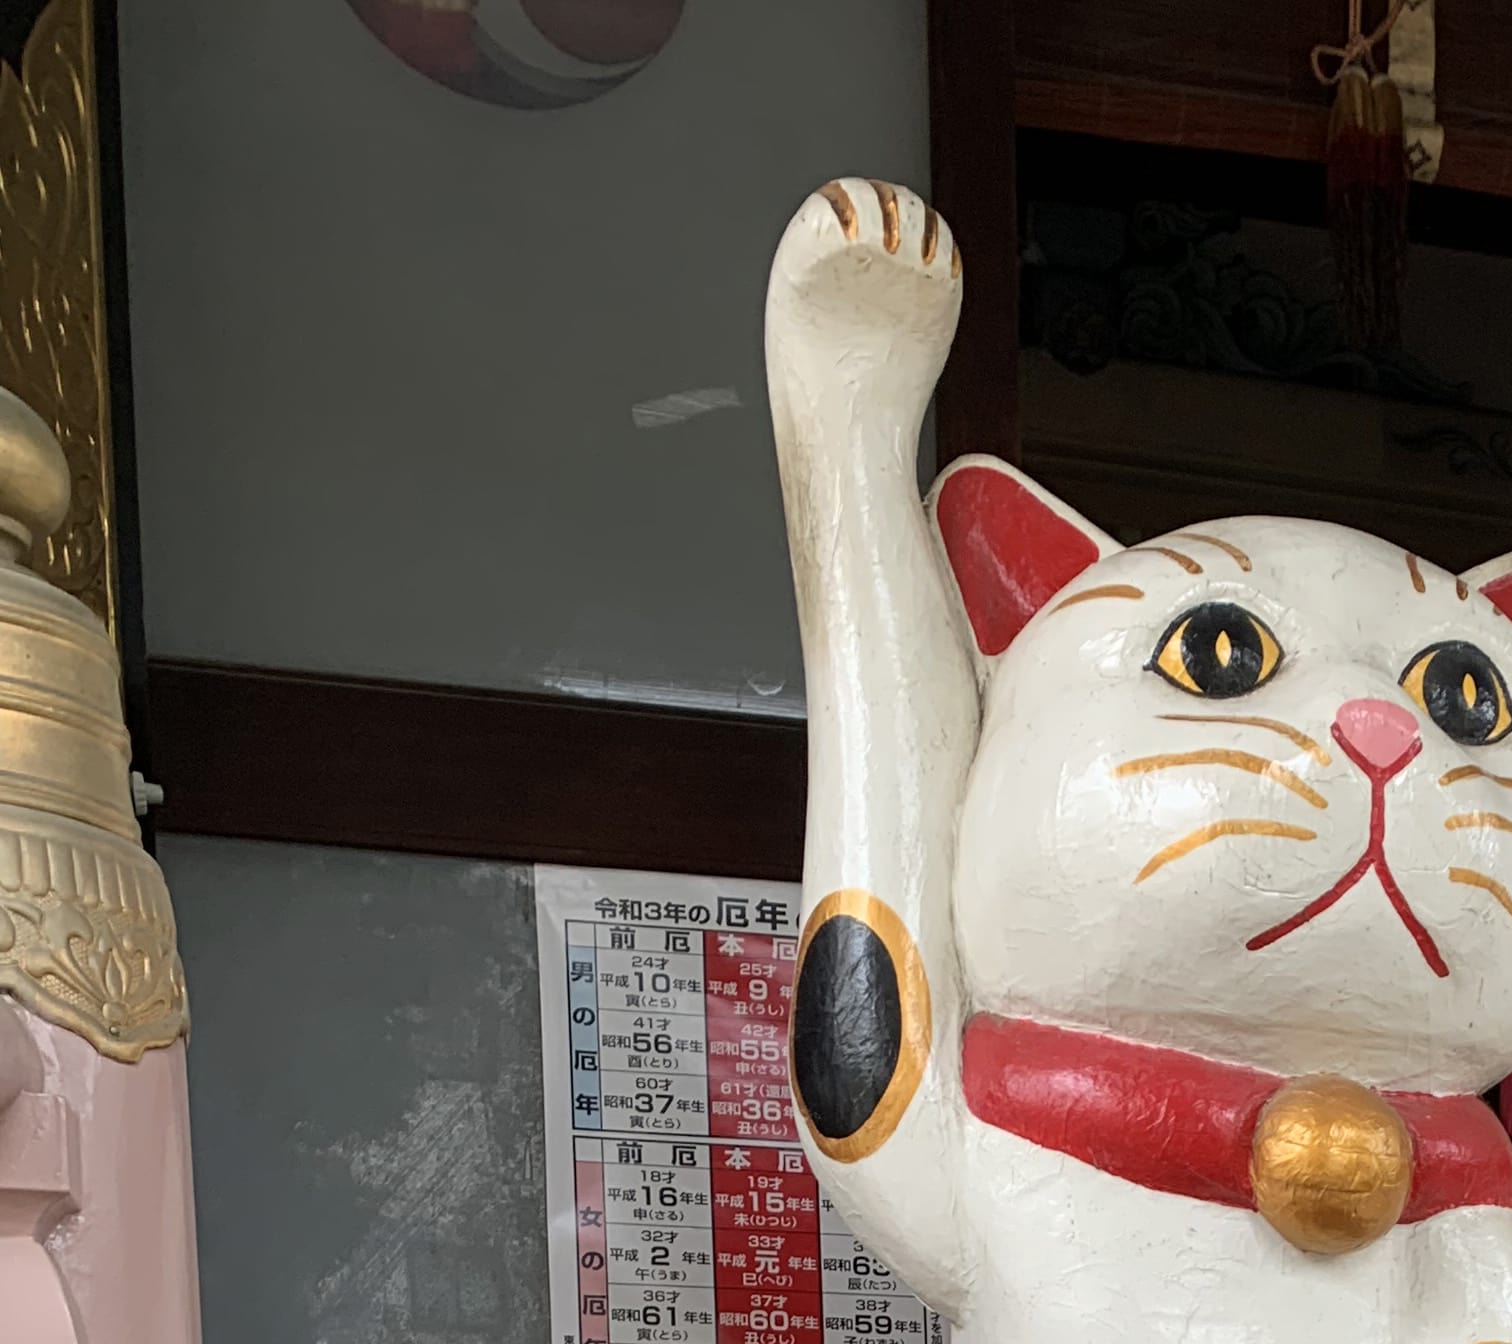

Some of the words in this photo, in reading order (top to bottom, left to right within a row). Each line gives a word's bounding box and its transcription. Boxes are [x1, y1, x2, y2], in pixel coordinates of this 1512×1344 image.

[632, 956, 669, 970] 24才
[740, 963, 776, 977] 25才
[633, 1017, 671, 1031] 41才
[741, 1024, 778, 1038] 42才
[602, 1032, 703, 1054] 昭和56年生
[636, 1077, 673, 1091] 60才
[604, 1092, 704, 1114] 昭和37年生
[640, 1170, 675, 1183] 18才
[748, 1176, 783, 1189] 19才
[641, 1230, 678, 1244] 32才
[748, 1236, 785, 1250] 33才
[643, 1290, 680, 1303] 36才
[750, 1295, 787, 1309] 37才
[856, 1299, 891, 1313] 38才
[612, 1306, 712, 1326] 昭和61年生
[720, 1310, 818, 1331] 昭和60年生
[826, 1315, 922, 1335] 昭和59年生
